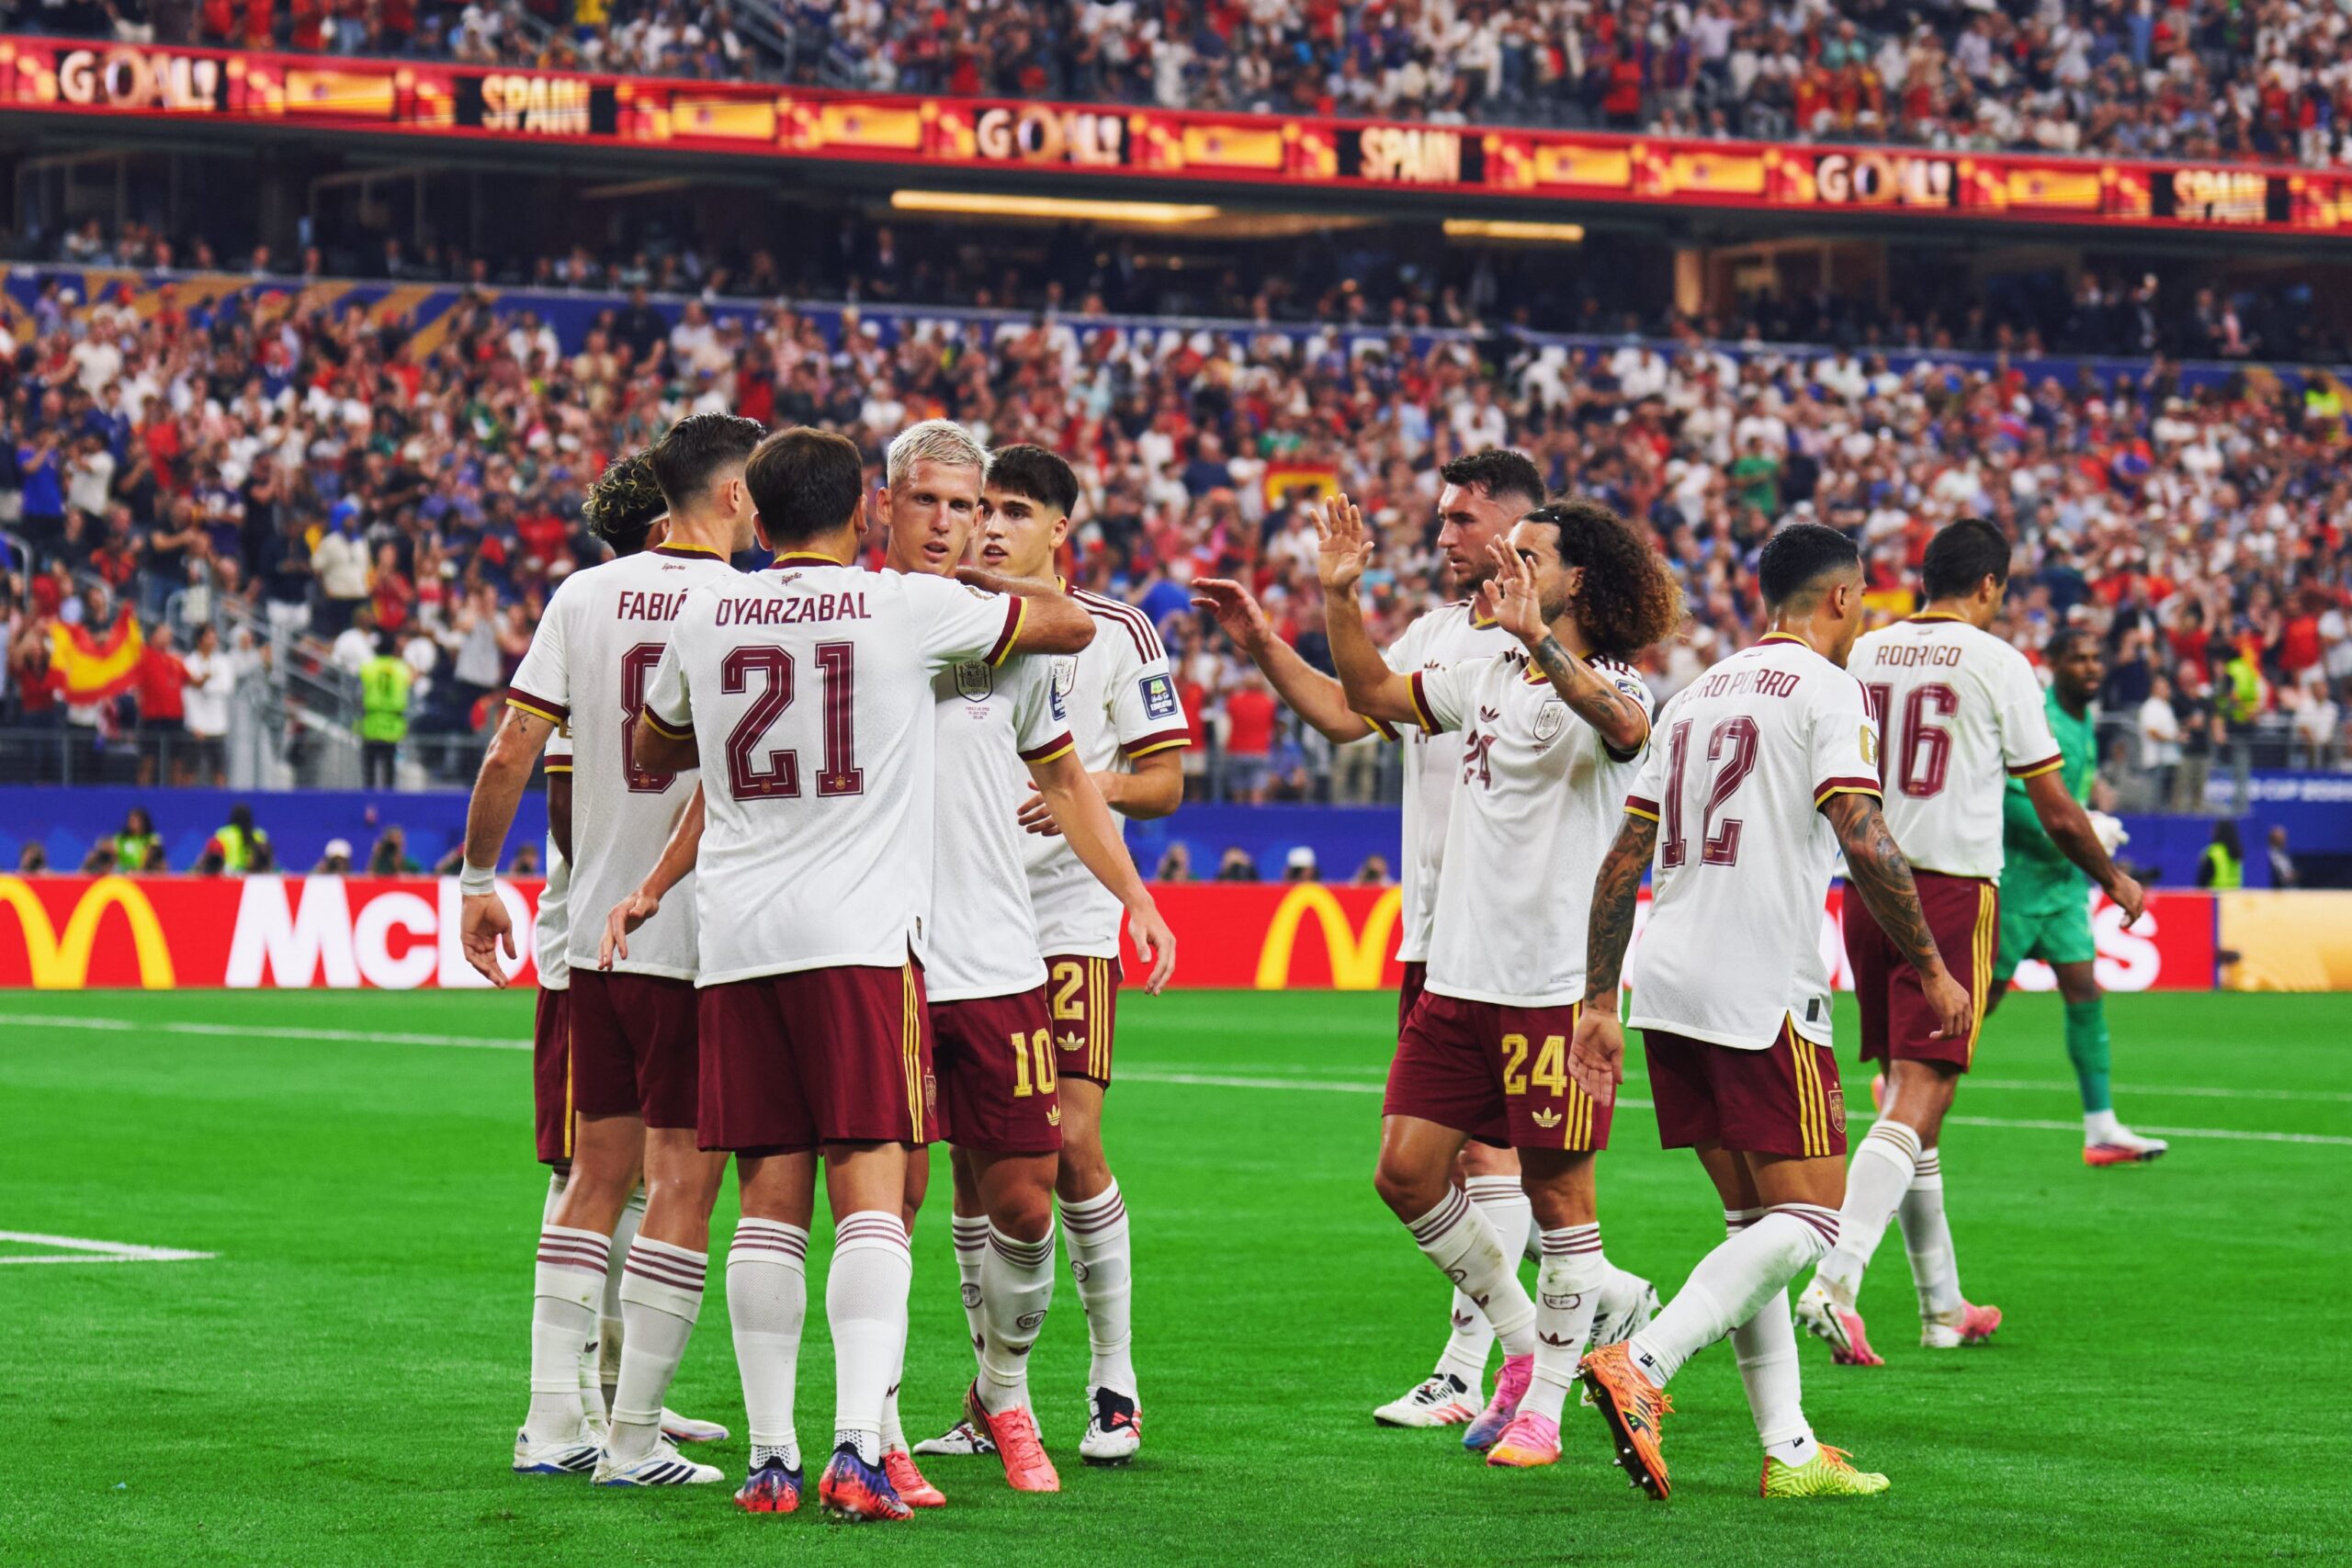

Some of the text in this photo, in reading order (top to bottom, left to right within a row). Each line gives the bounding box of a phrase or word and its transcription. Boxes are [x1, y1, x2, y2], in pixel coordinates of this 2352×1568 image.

[60, 50, 218, 110] GOAL!
[481, 73, 591, 134] SPAIN
[1360, 127, 1460, 184] SPAIN
[715, 592, 872, 626] OYARZABAL
[1727, 669, 1801, 698] PORRO
[1875, 645, 1962, 668] RODRIGO
[721, 641, 864, 802] 21
[1867, 682, 1960, 800] 16
[1662, 716, 1760, 868] 12
[224, 875, 537, 988] McD
[1011, 1028, 1057, 1098] 10
[1501, 1033, 1567, 1097] 24
